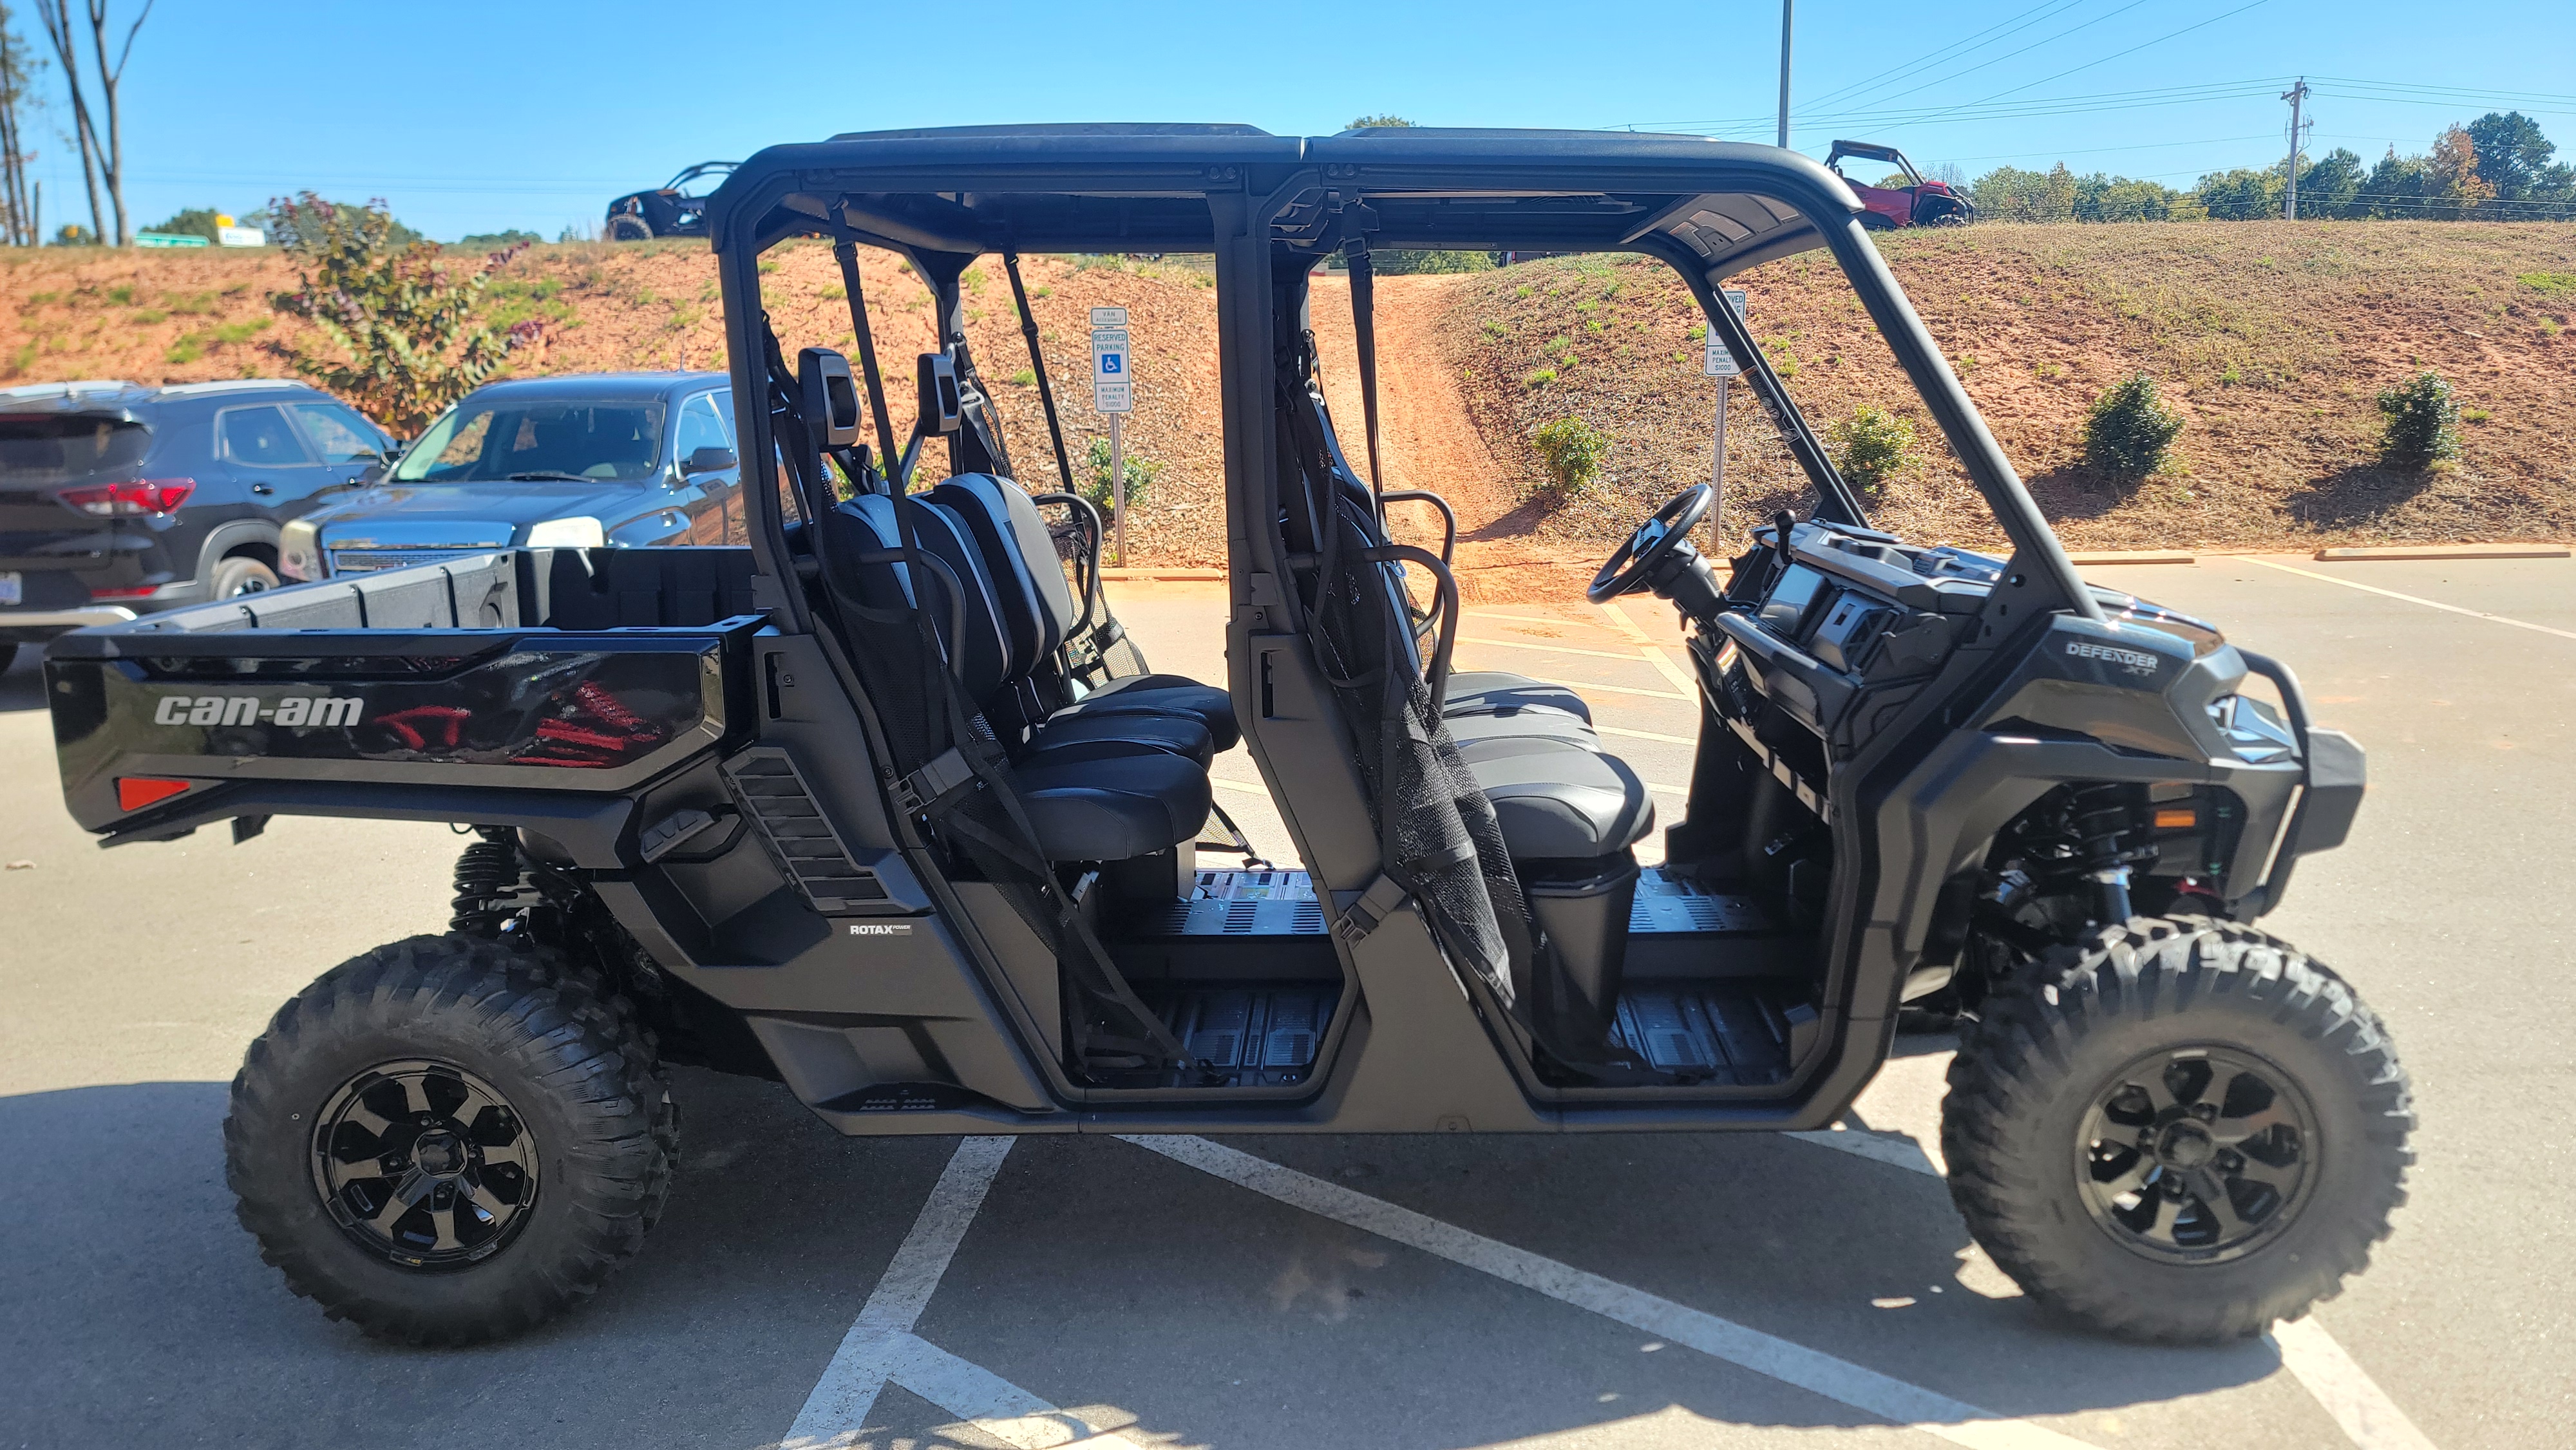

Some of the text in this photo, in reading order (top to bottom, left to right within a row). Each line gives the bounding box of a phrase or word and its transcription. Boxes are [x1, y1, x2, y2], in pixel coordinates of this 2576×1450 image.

[1094, 334, 1126, 342] RESERVED
[1097, 343, 1124, 352] PARKING
[2065, 643, 2157, 669] DEFENDER
[2123, 666, 2157, 676] XT
[155, 696, 365, 726] can-am
[850, 925, 893, 935] ROTAX
